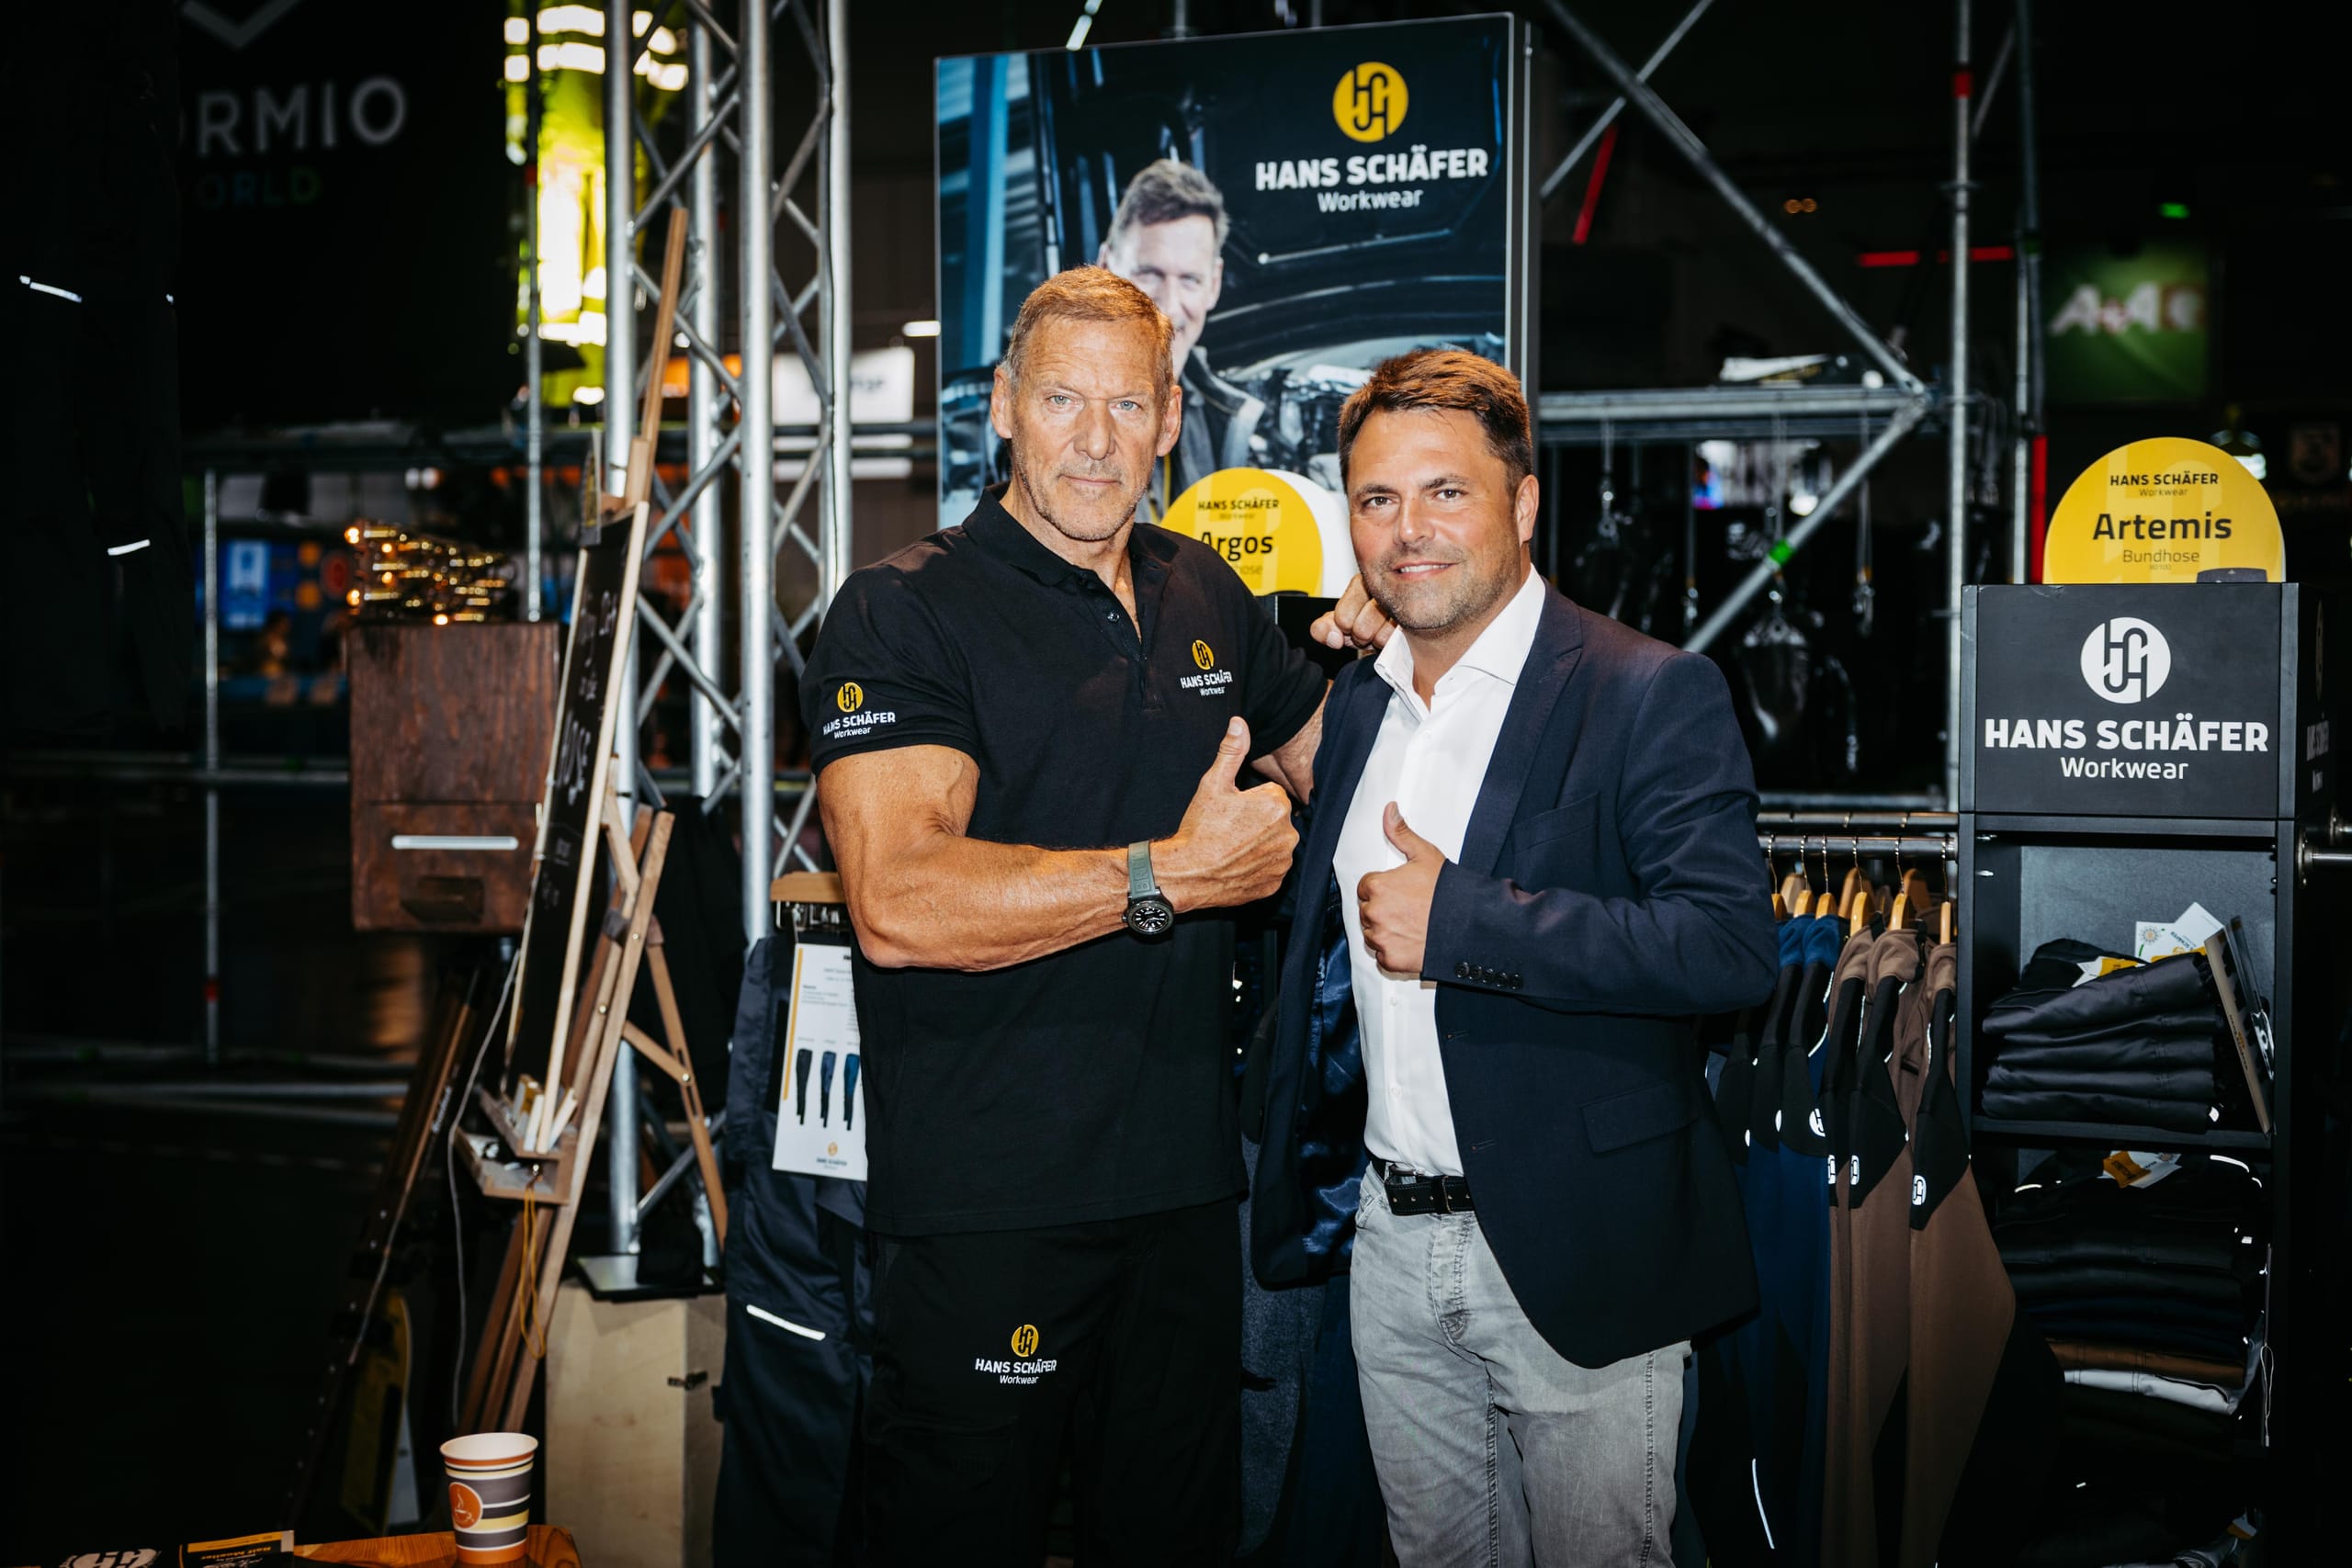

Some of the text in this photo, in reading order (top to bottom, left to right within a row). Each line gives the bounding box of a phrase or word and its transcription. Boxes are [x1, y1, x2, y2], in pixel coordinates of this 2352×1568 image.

[178, 73, 410, 160] RMIO
[1256, 144, 1488, 191] HANS SCHÄFER
[194, 163, 322, 212] ORLD
[1317, 190, 1424, 213] Workwear
[2110, 470, 2220, 486] HANS SCHÄFER
[2139, 487, 2188, 497] Workwear
[1198, 498, 1279, 511] HANS SCHÄFER
[2093, 511, 2233, 540] Artemis
[2122, 549, 2200, 563] Bundhose
[842, 711, 896, 728] SCHÄFER
[833, 727, 872, 739] Workwear
[1984, 718, 2087, 750] HANS
[2096, 712, 2269, 751] SCHÄFER
[2060, 756, 2189, 780] Workwear
[975, 1358, 1057, 1374] HANS SCHÄFER
[999, 1374, 1039, 1385] Workwear
